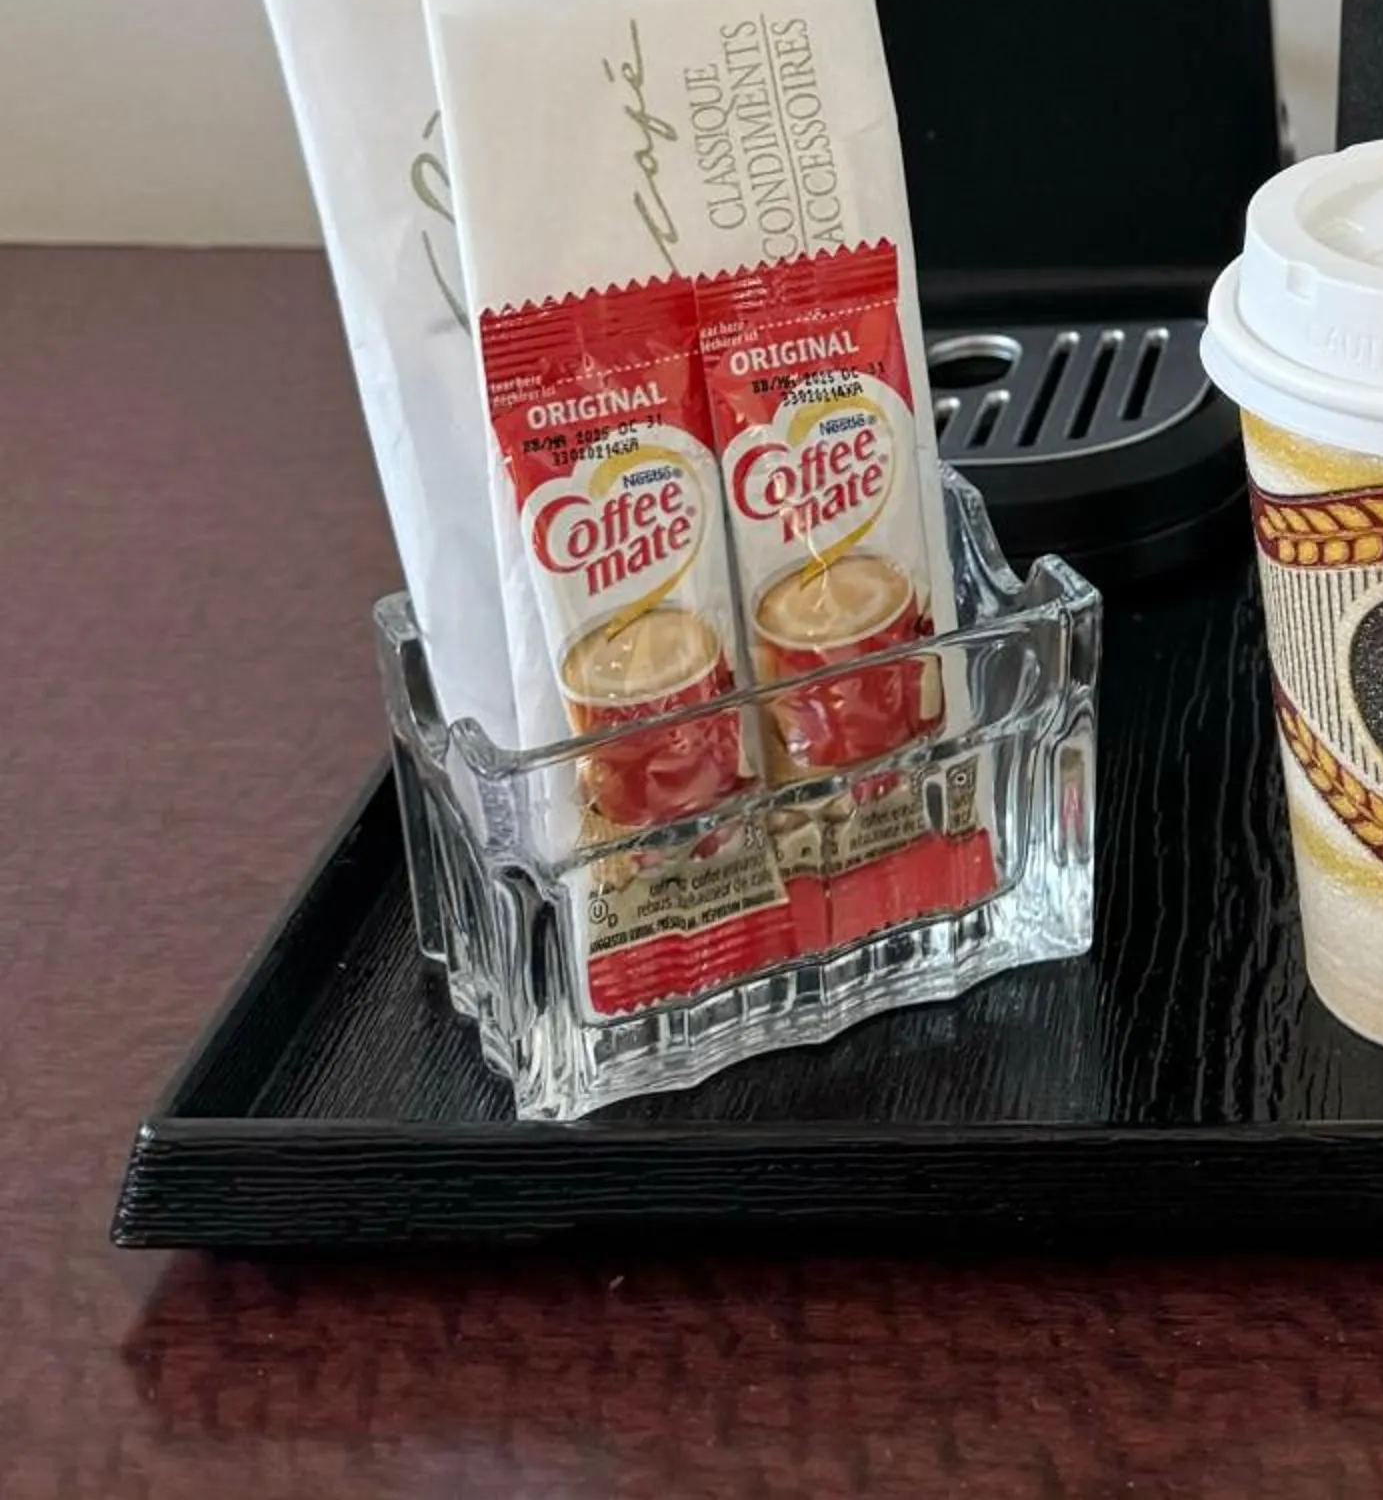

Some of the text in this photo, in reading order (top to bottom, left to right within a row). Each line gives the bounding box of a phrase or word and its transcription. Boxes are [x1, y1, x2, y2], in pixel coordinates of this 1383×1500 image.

[684, 63, 748, 231] CLASSIQUE
[720, 20, 799, 260] CONDIMENTS
[771, 18, 845, 244] ACCESSOIRES
[730, 330, 860, 376] ORIGINAL
[526, 380, 668, 430] ORIGINAL
[732, 427, 876, 521] Coffee
[780, 462, 884, 544] mate
[531, 481, 683, 574] Coffee
[583, 514, 691, 597] mate
